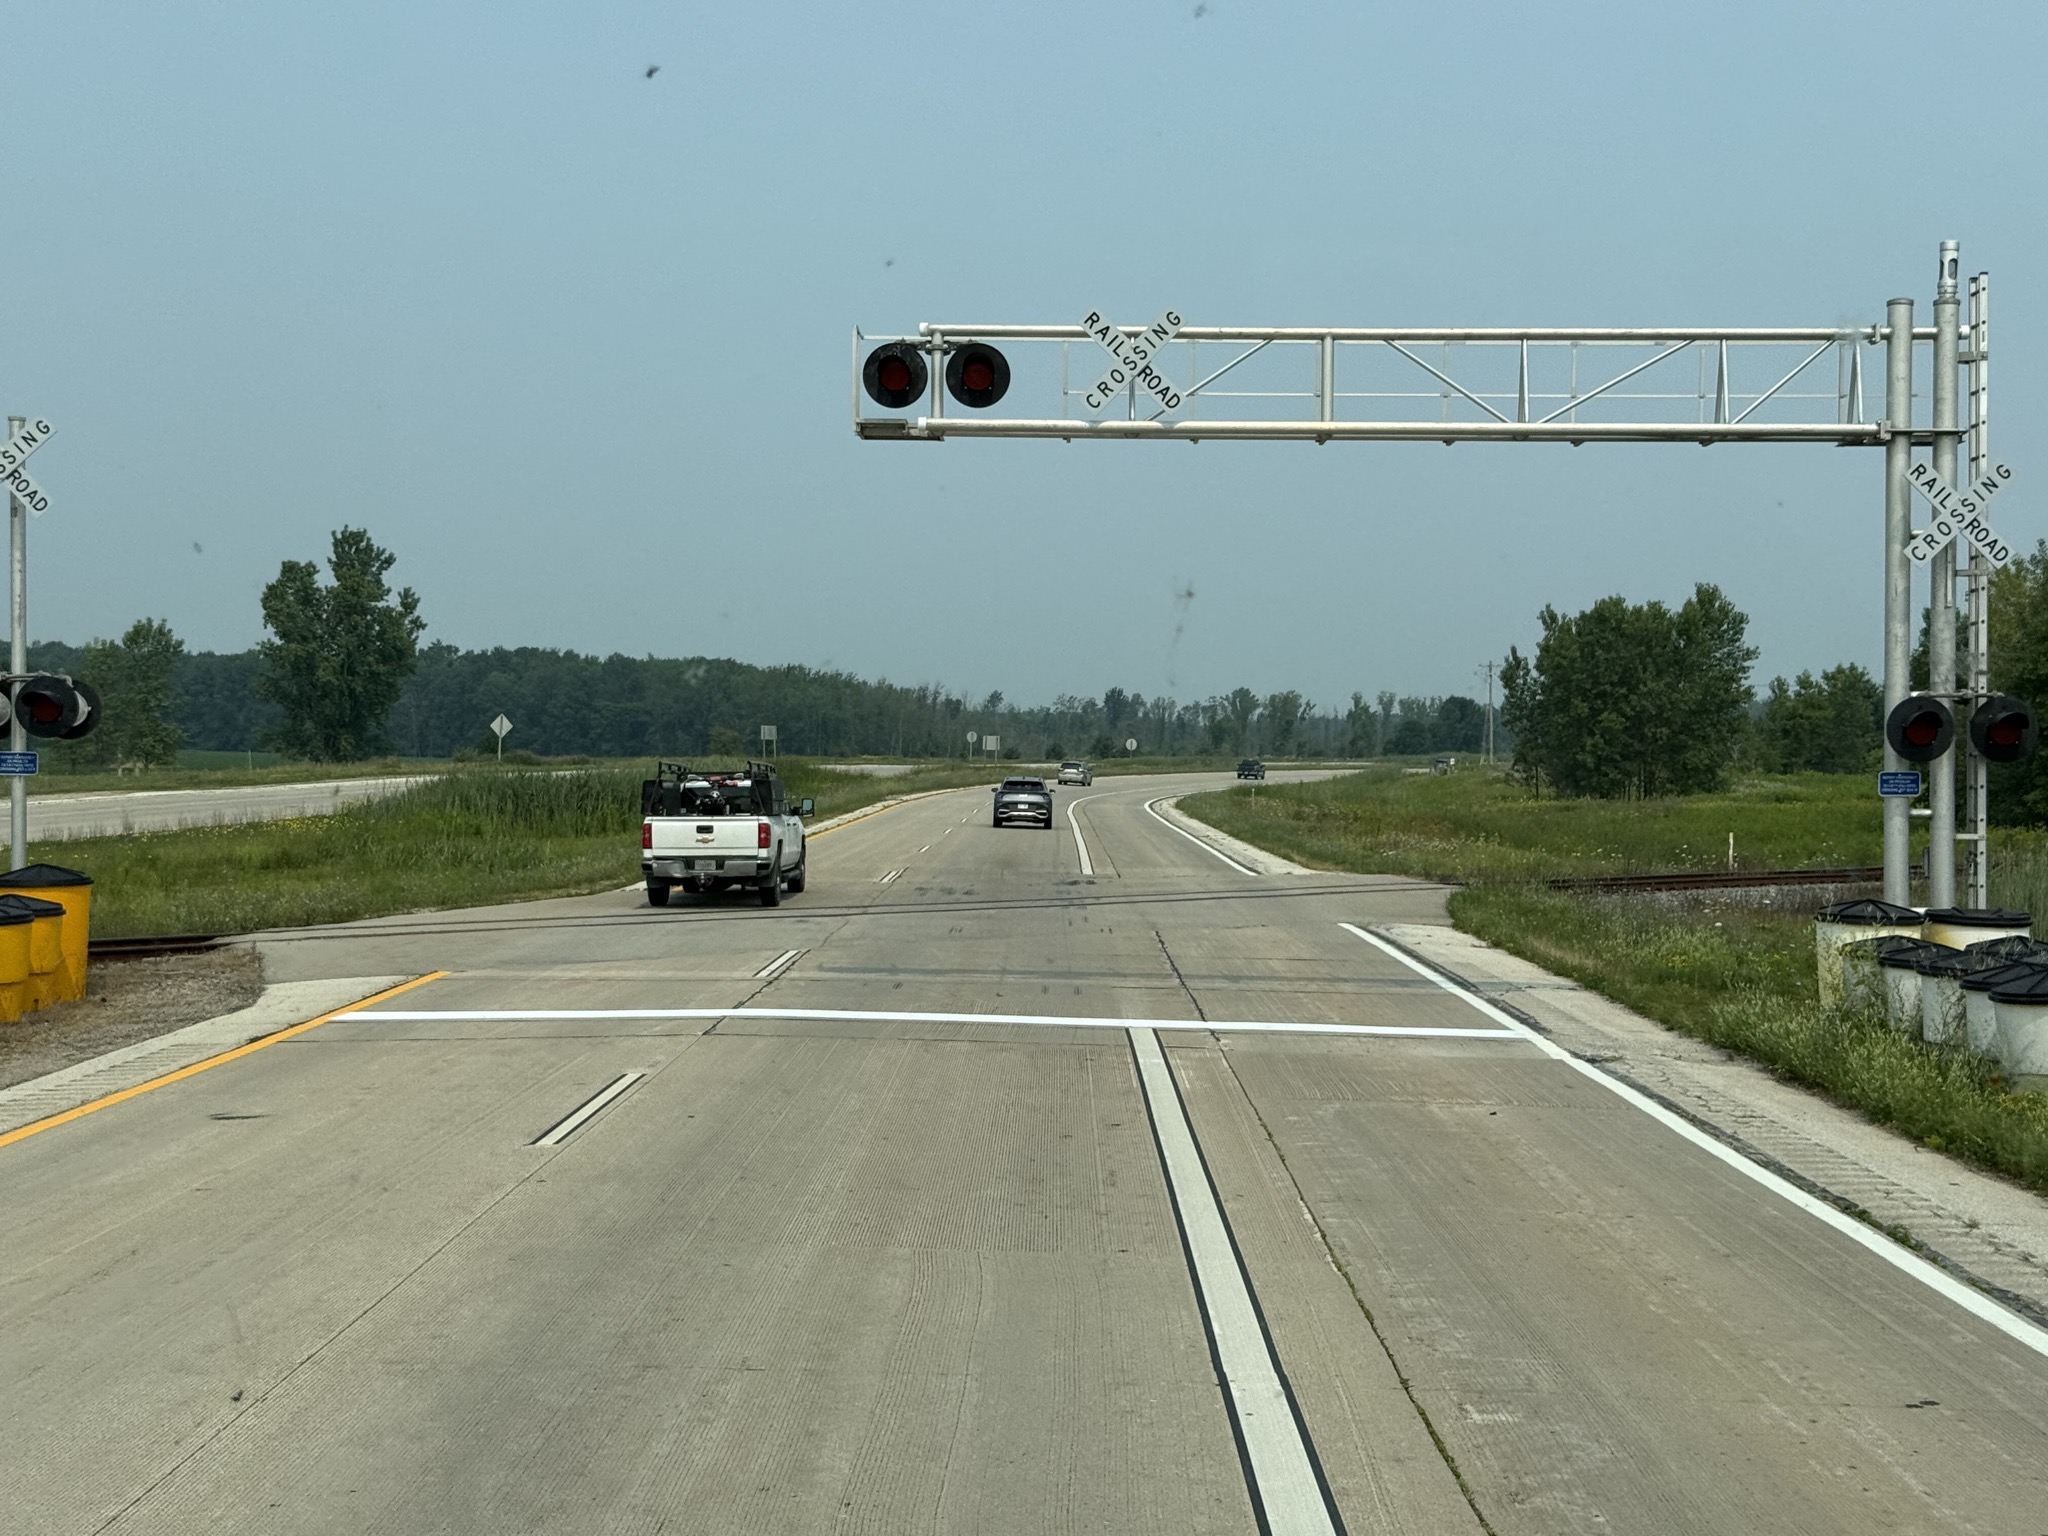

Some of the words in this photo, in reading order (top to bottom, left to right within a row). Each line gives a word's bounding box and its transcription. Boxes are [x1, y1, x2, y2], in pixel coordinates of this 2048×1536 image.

[1086, 311, 1181, 408] CROSSING
[6, 469, 48, 511] ROAD
[1911, 464, 2011, 561] CROSSING
